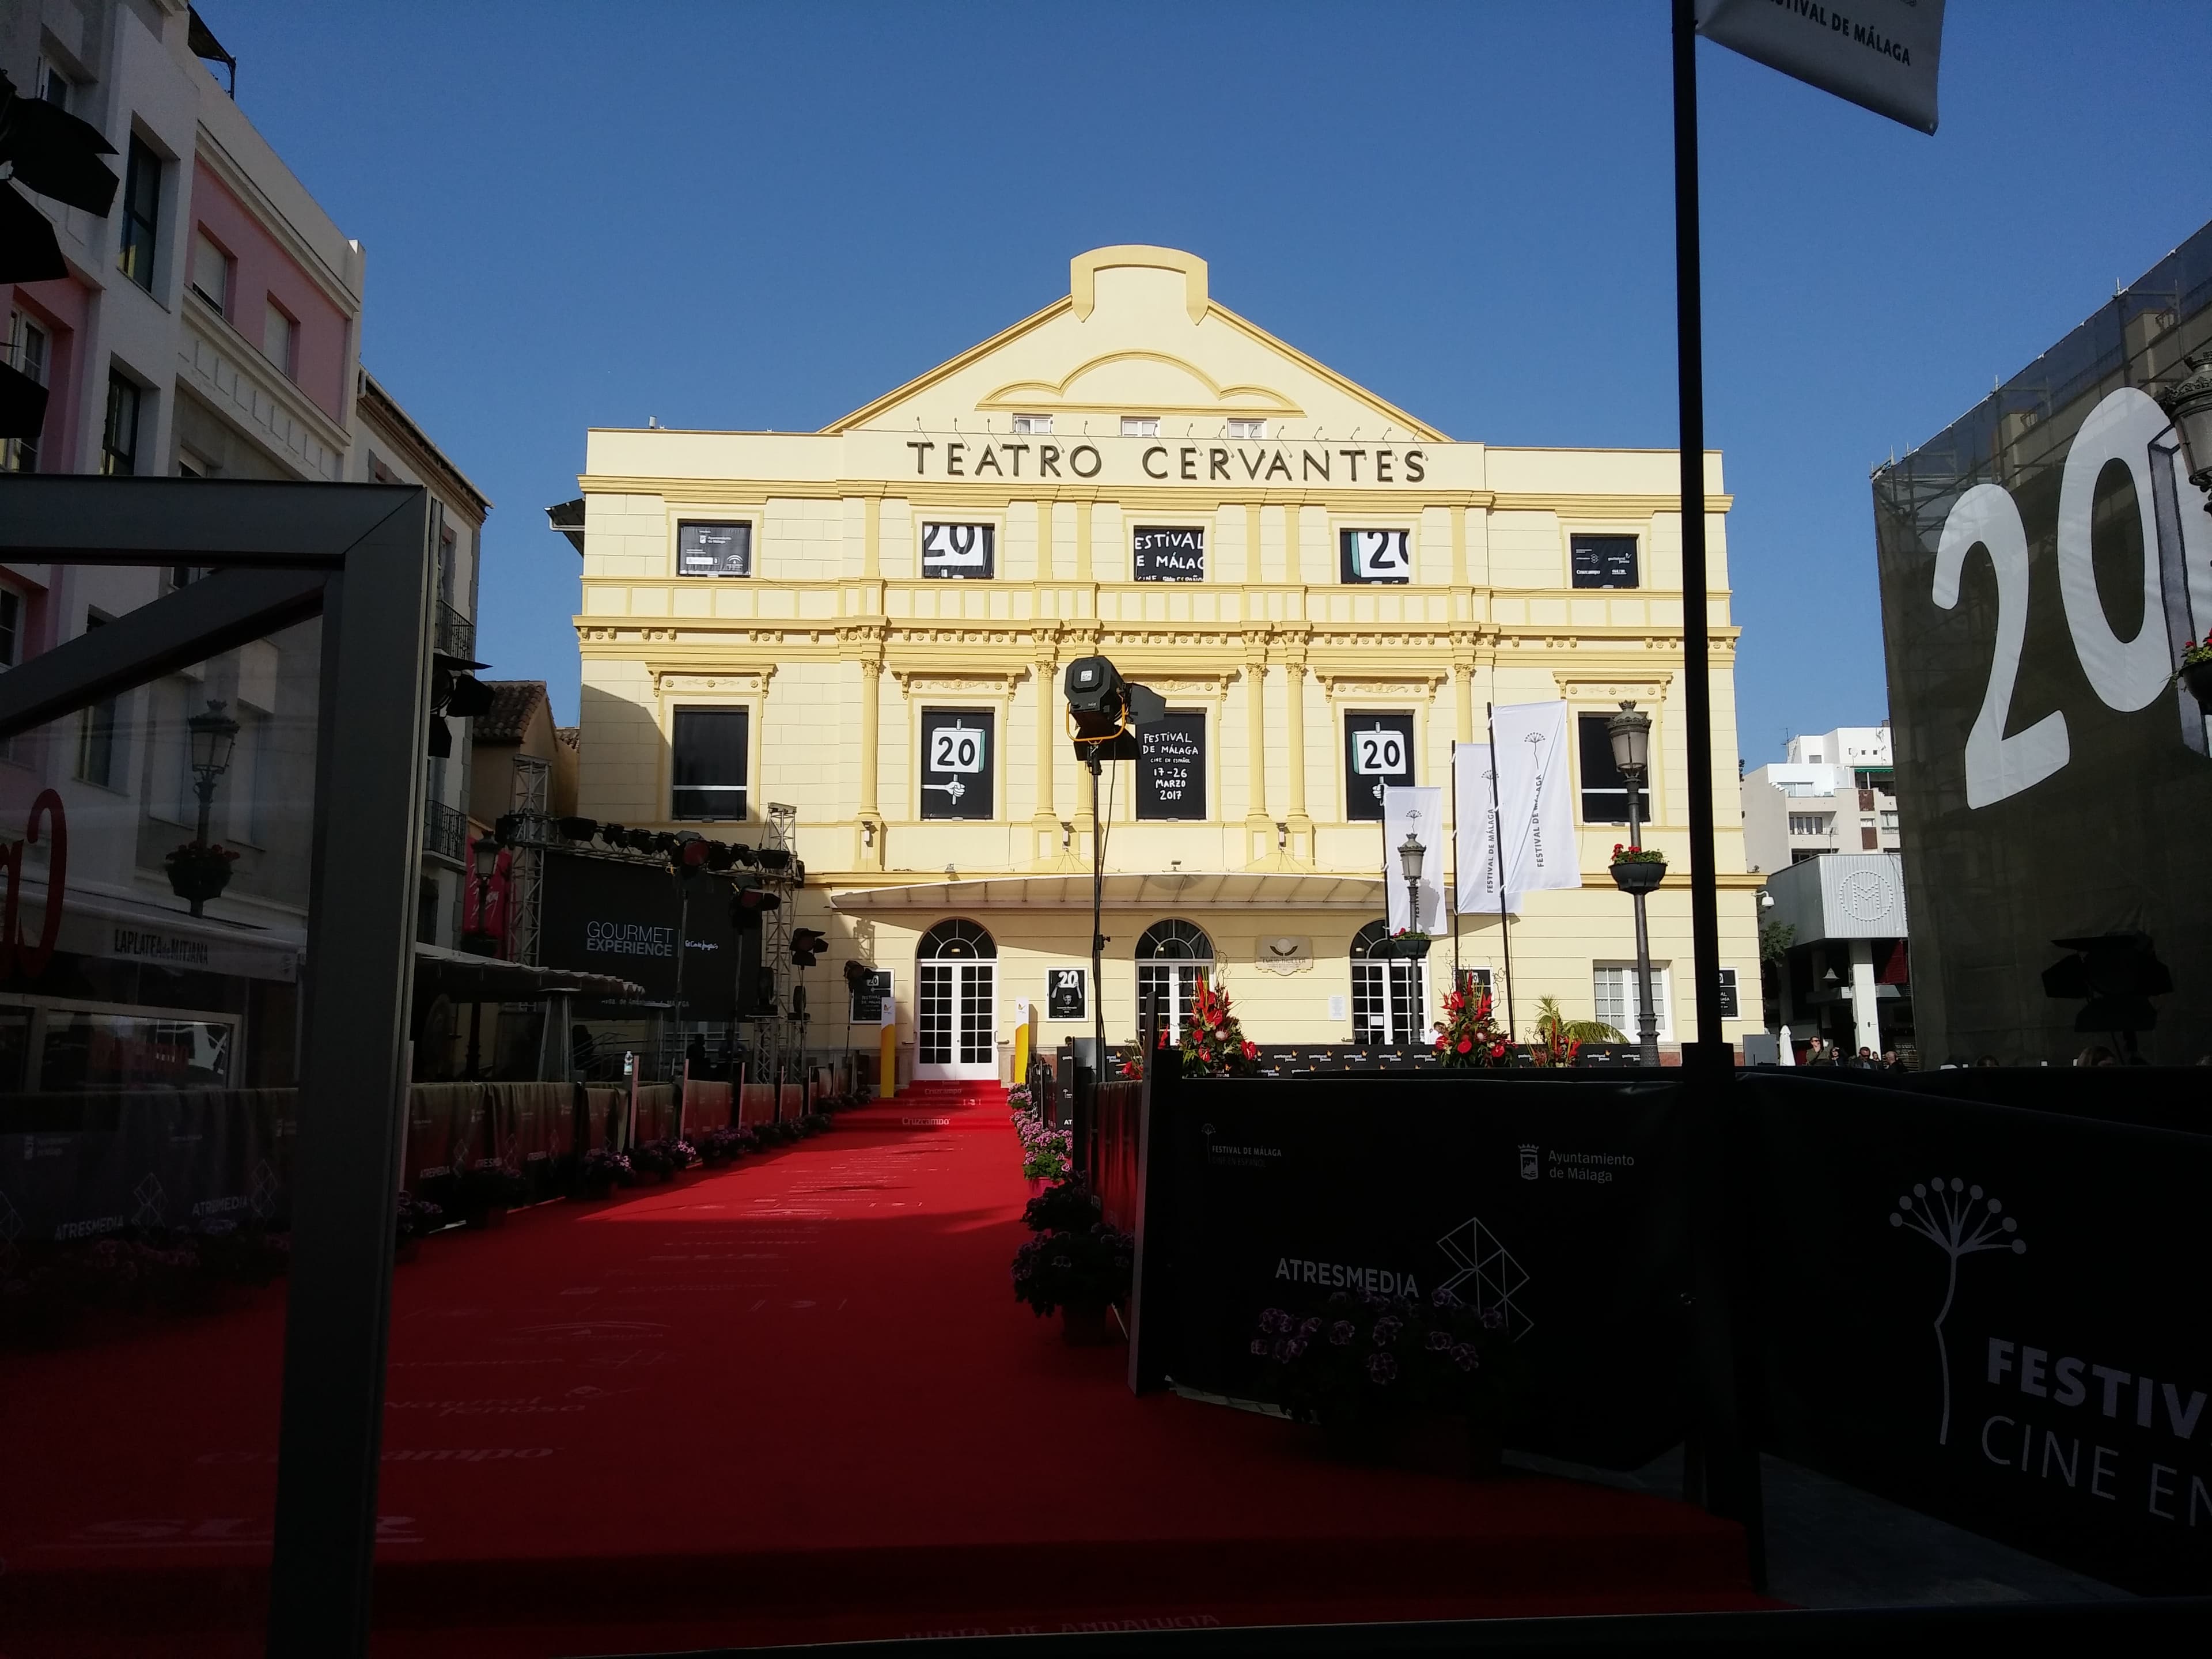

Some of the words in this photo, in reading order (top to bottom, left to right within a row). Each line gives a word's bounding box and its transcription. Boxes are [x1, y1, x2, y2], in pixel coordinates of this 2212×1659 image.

[1831, 13, 1849, 36] DE
[1854, 25, 1910, 66] MÁLAGA
[906, 441, 1102, 478] TEATRO
[1142, 446, 1426, 483] CERVANTES
[1931, 387, 2173, 810] 20
[937, 736, 975, 766] 20
[1142, 745, 1156, 755] DE
[1161, 744, 1199, 755] MÁLAGA
[1363, 740, 1400, 768] 20
[1156, 779, 1186, 789] MARZO
[1160, 790, 1182, 800] 2017
[1532, 813, 1539, 824] DE
[1488, 844, 1494, 854] DE
[1533, 827, 1544, 868] FESTIVAL
[586, 921, 674, 944] GOURMET
[586, 938, 673, 957] EXPERIENCE
[1058, 971, 1079, 988] 20
[1212, 1145, 1241, 1155] FESTIVAL
[1243, 1147, 1252, 1155] DE
[1253, 1145, 1282, 1157] MÁLAGA
[1548, 1150, 1635, 1166] Ayuntamiento
[1550, 1166, 1564, 1179] de
[1567, 1168, 1613, 1184] Málaga
[55, 1215, 124, 1241] ATRESMEDIA
[1275, 1258, 1419, 1298] ATRESMEDIA
[1987, 1336, 2212, 1440] FESTIV
[1982, 1414, 2120, 1501] CINE
[2147, 1462, 2212, 1528] EN
